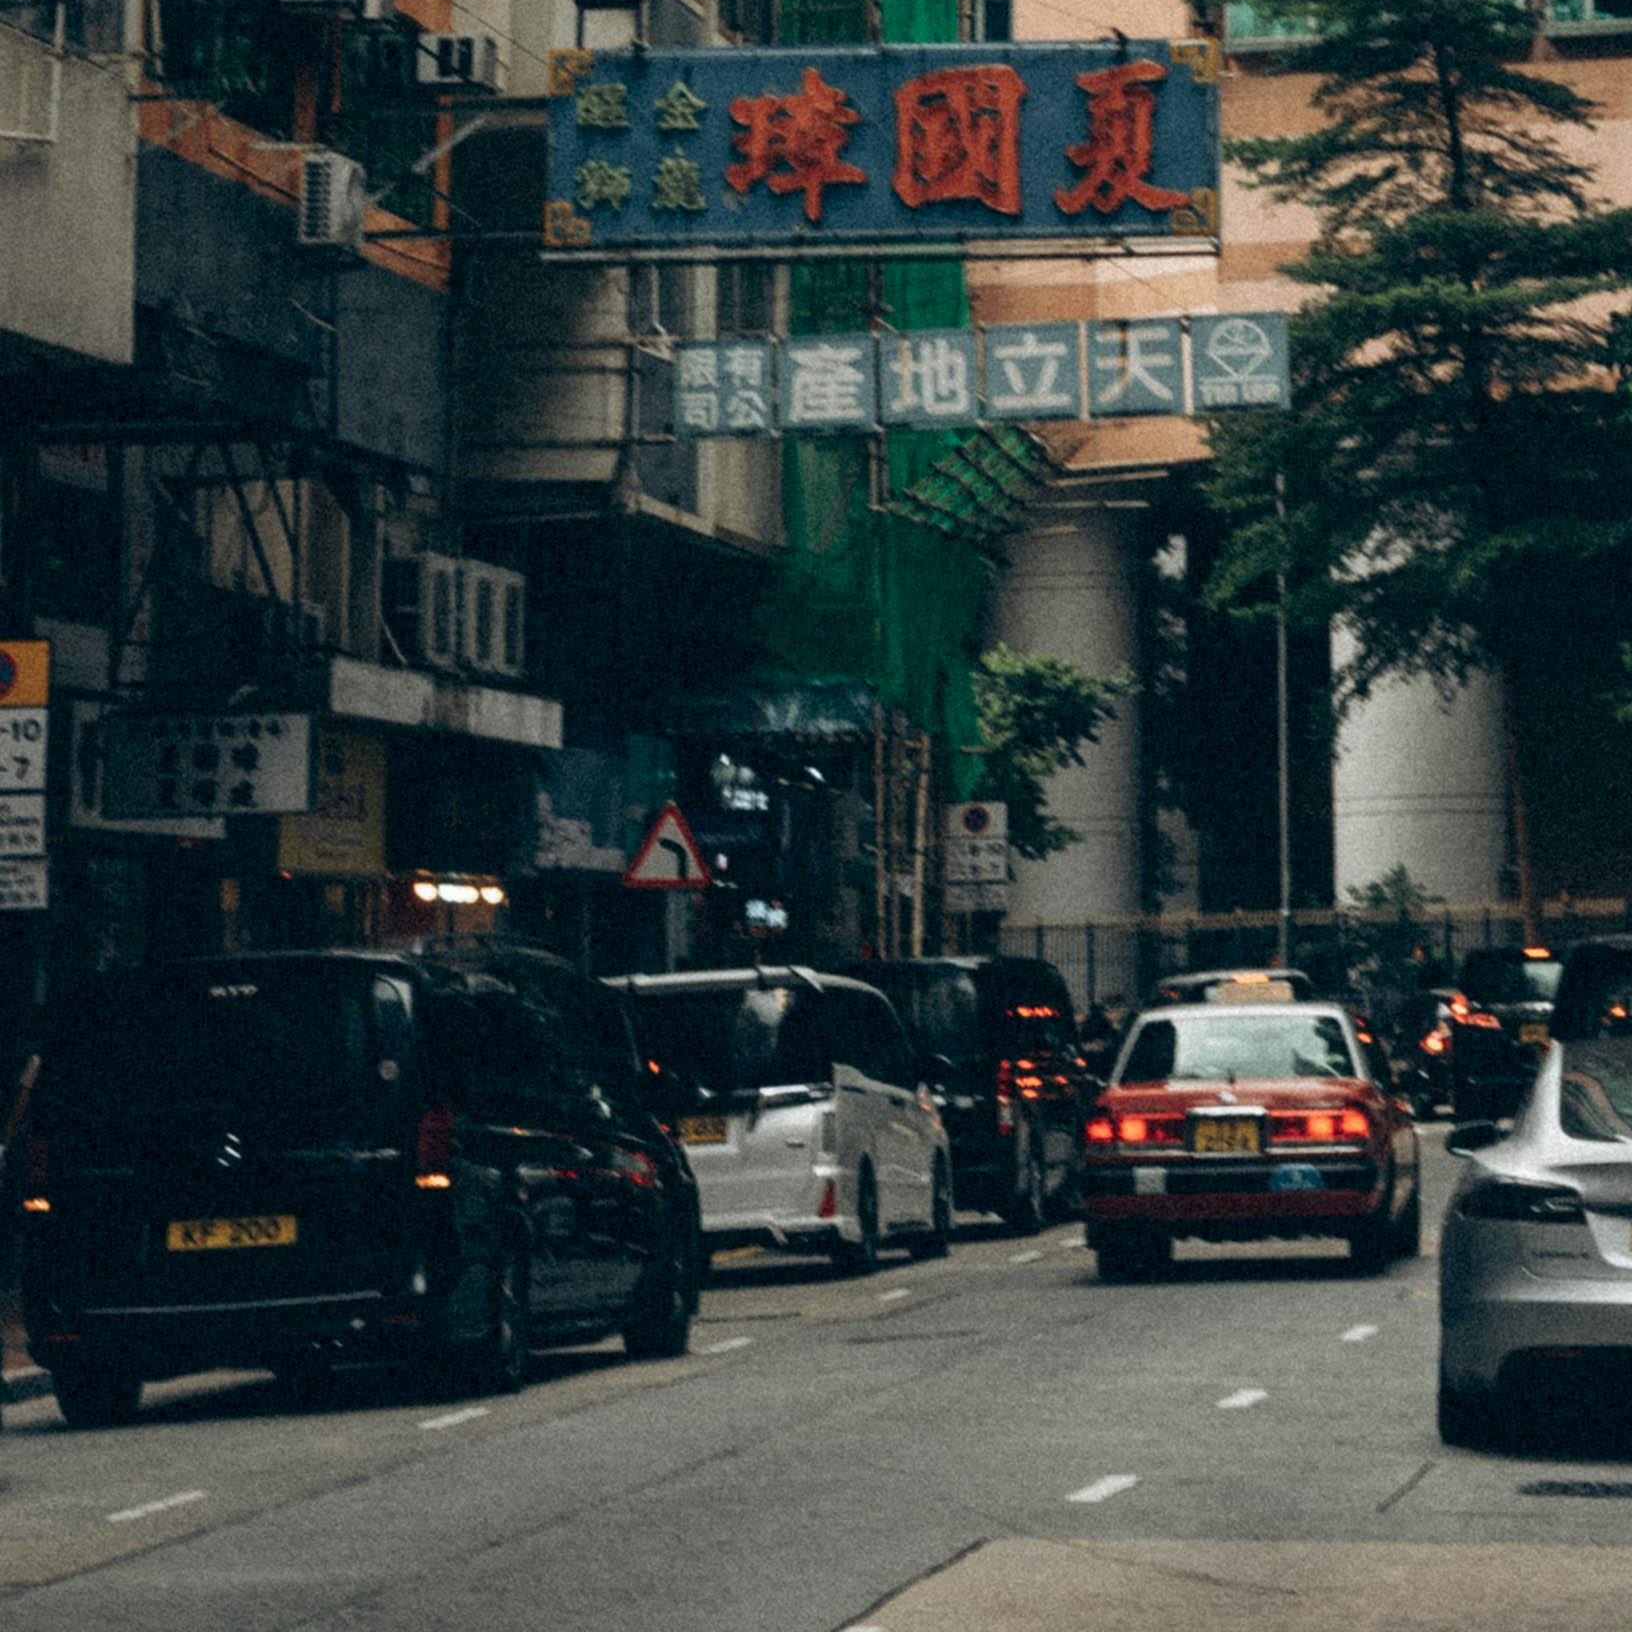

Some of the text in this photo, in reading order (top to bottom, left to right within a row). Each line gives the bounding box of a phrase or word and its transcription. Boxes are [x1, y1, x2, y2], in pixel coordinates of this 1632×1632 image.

[725, 57, 1194, 222] 夏國璋
[788, 325, 1174, 422] 天立地產
